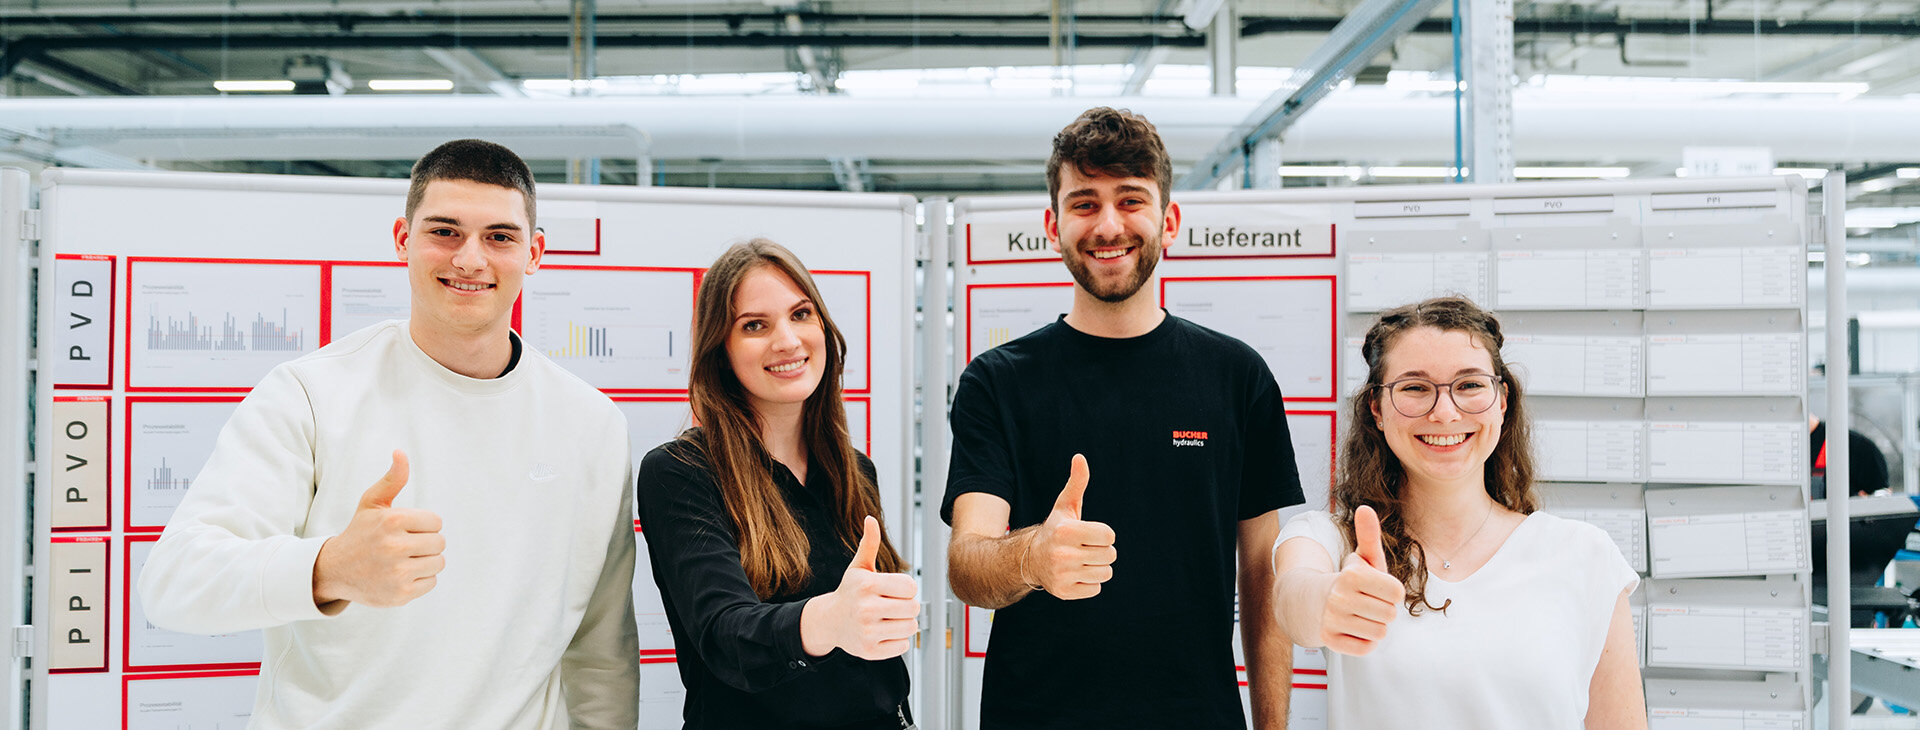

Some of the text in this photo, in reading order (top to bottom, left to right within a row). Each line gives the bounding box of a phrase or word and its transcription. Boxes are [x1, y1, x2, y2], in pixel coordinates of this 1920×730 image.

[1188, 227, 1302, 248] Lieferant
[1172, 430, 1208, 440] BUCHER
[1172, 438, 1205, 448] hydraulics
